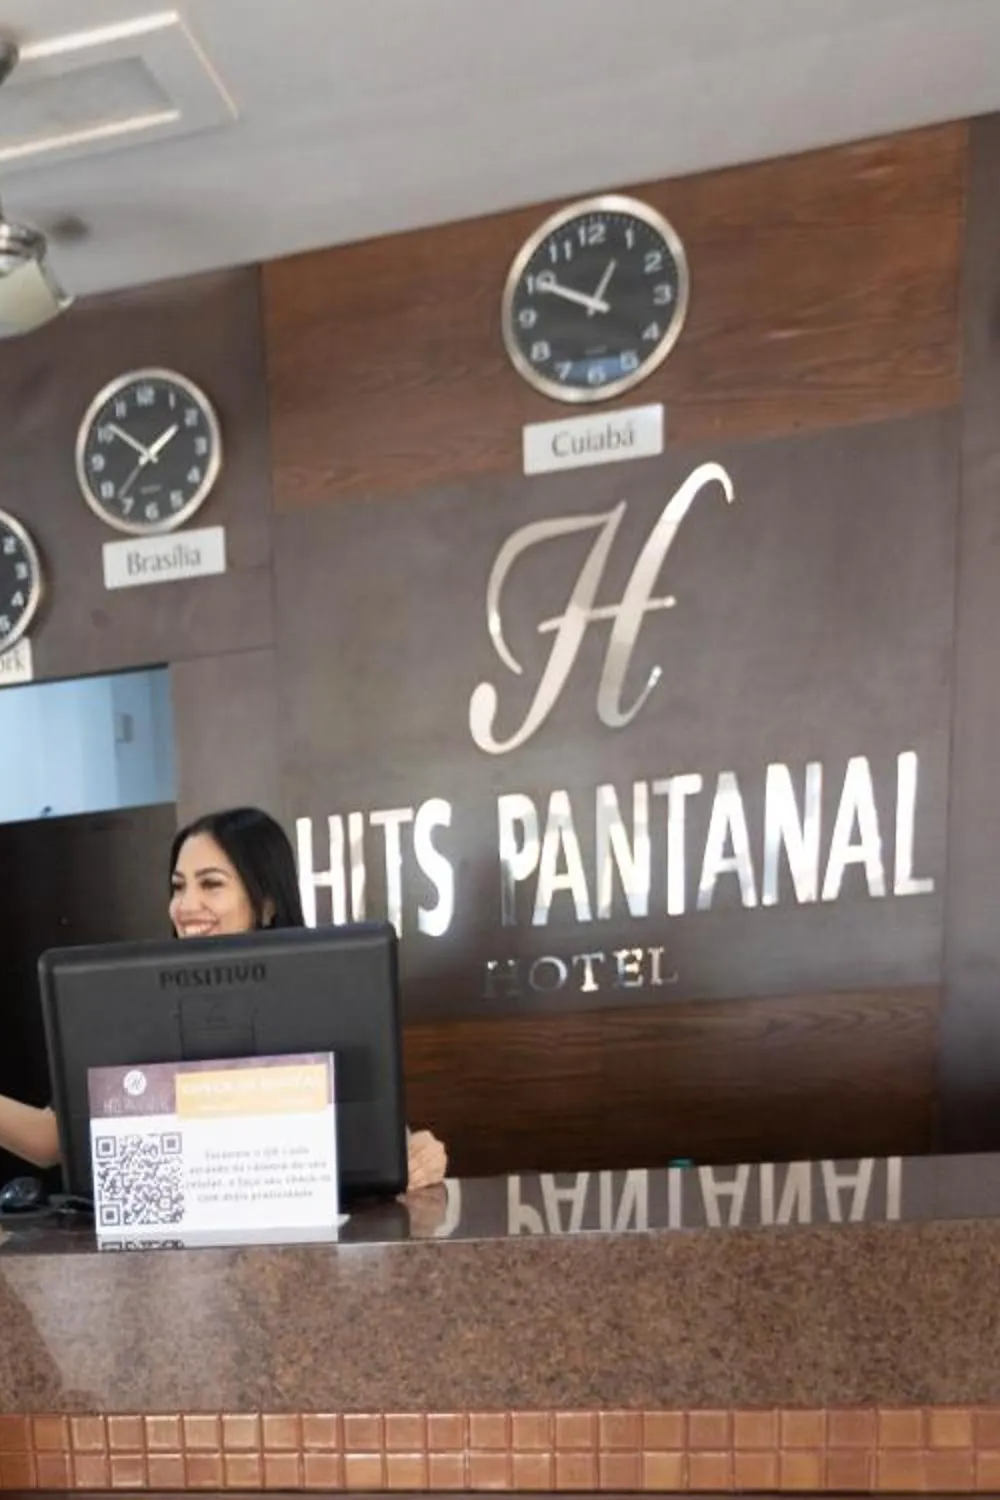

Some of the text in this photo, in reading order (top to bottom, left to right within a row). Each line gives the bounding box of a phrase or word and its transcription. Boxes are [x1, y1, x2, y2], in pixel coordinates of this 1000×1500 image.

[578, 223, 606, 247] 12
[625, 227, 635, 249] 1
[549, 240, 572, 263] 11
[644, 251, 662, 273] 2
[526, 270, 557, 294] 10
[652, 284, 672, 304] 3
[519, 308, 537, 328] 9
[642, 321, 659, 341] 4
[531, 341, 550, 361] 8
[619, 350, 638, 371] 5
[555, 361, 572, 380] 7
[587, 364, 606, 384] 6
[551, 419, 635, 458] Cuiabá
[127, 543, 202, 577] Brasília
[296, 751, 934, 938] HITS PANTANAL
[160, 962, 268, 990] POSITIVO
[482, 946, 679, 999] HOTEL
